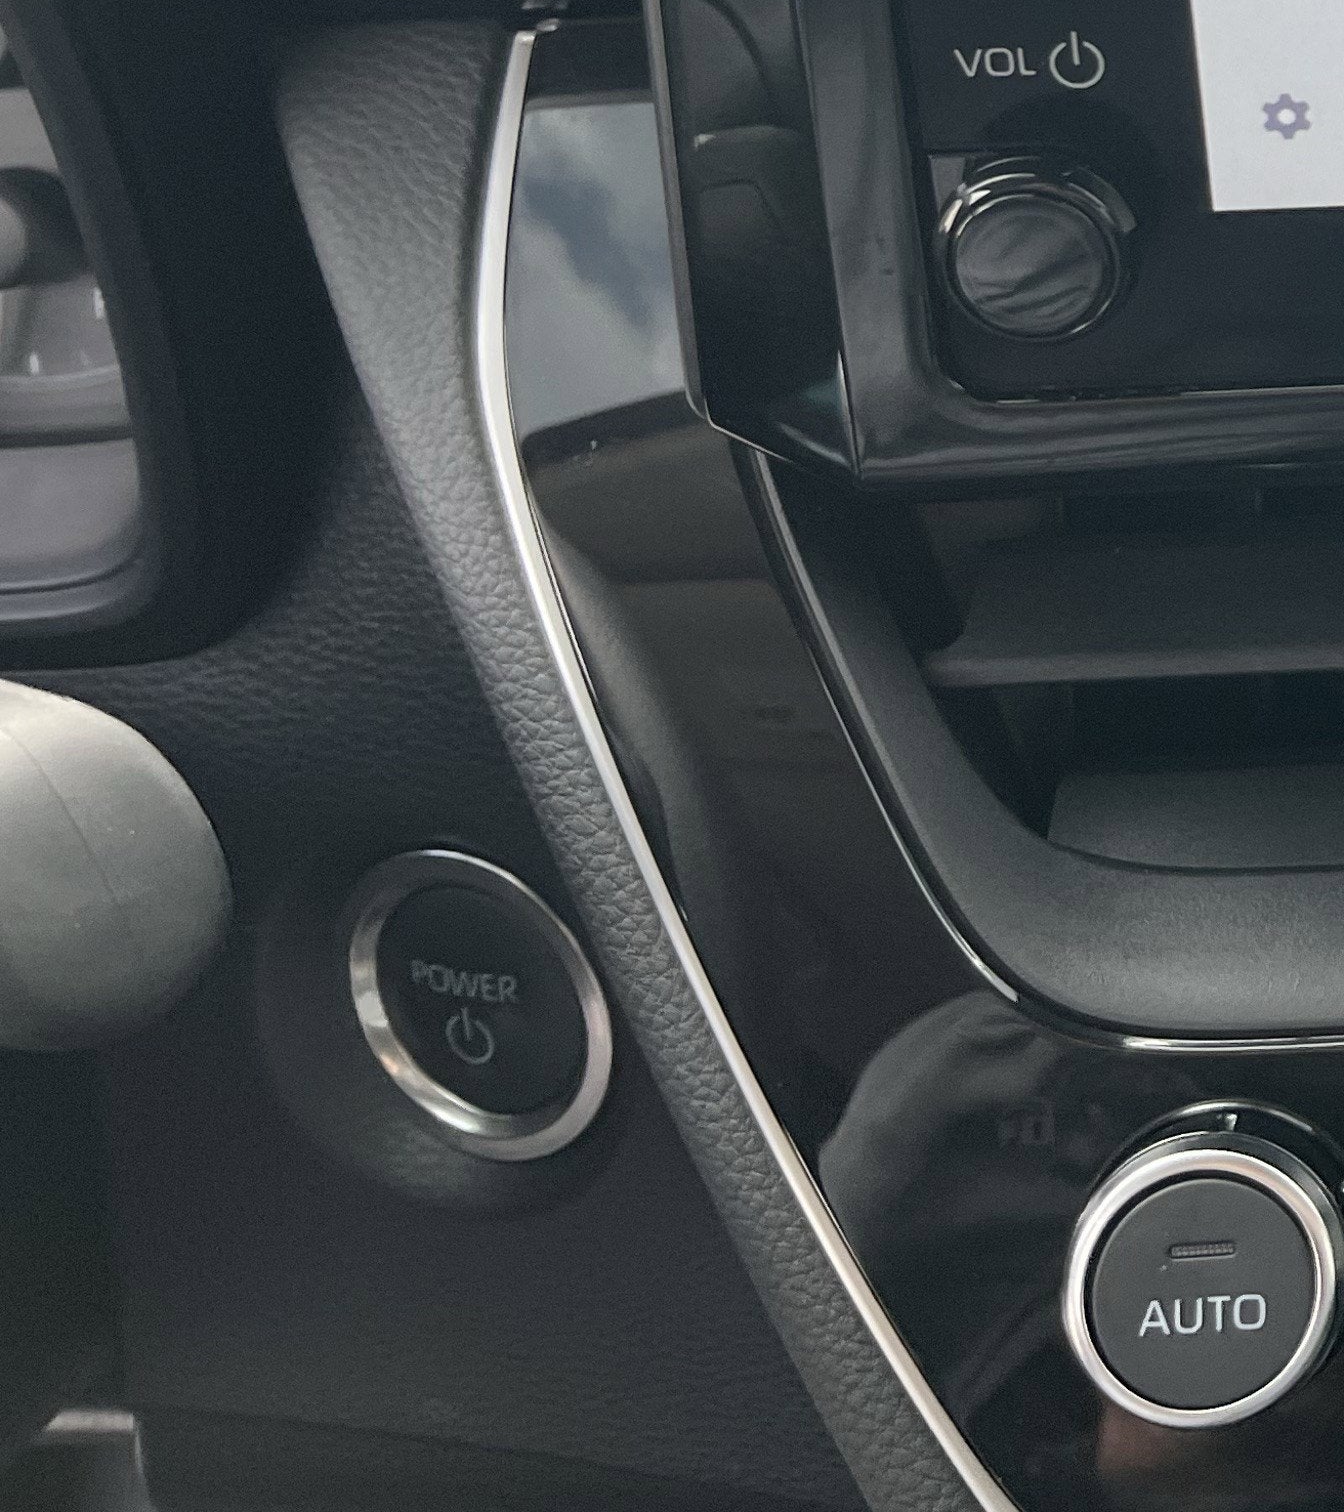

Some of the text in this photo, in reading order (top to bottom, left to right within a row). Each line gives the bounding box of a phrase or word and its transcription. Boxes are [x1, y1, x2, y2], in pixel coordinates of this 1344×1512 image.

[953, 47, 1037, 78] VOL
[410, 959, 517, 1003] POWER
[1138, 1293, 1268, 1337] AUTO
